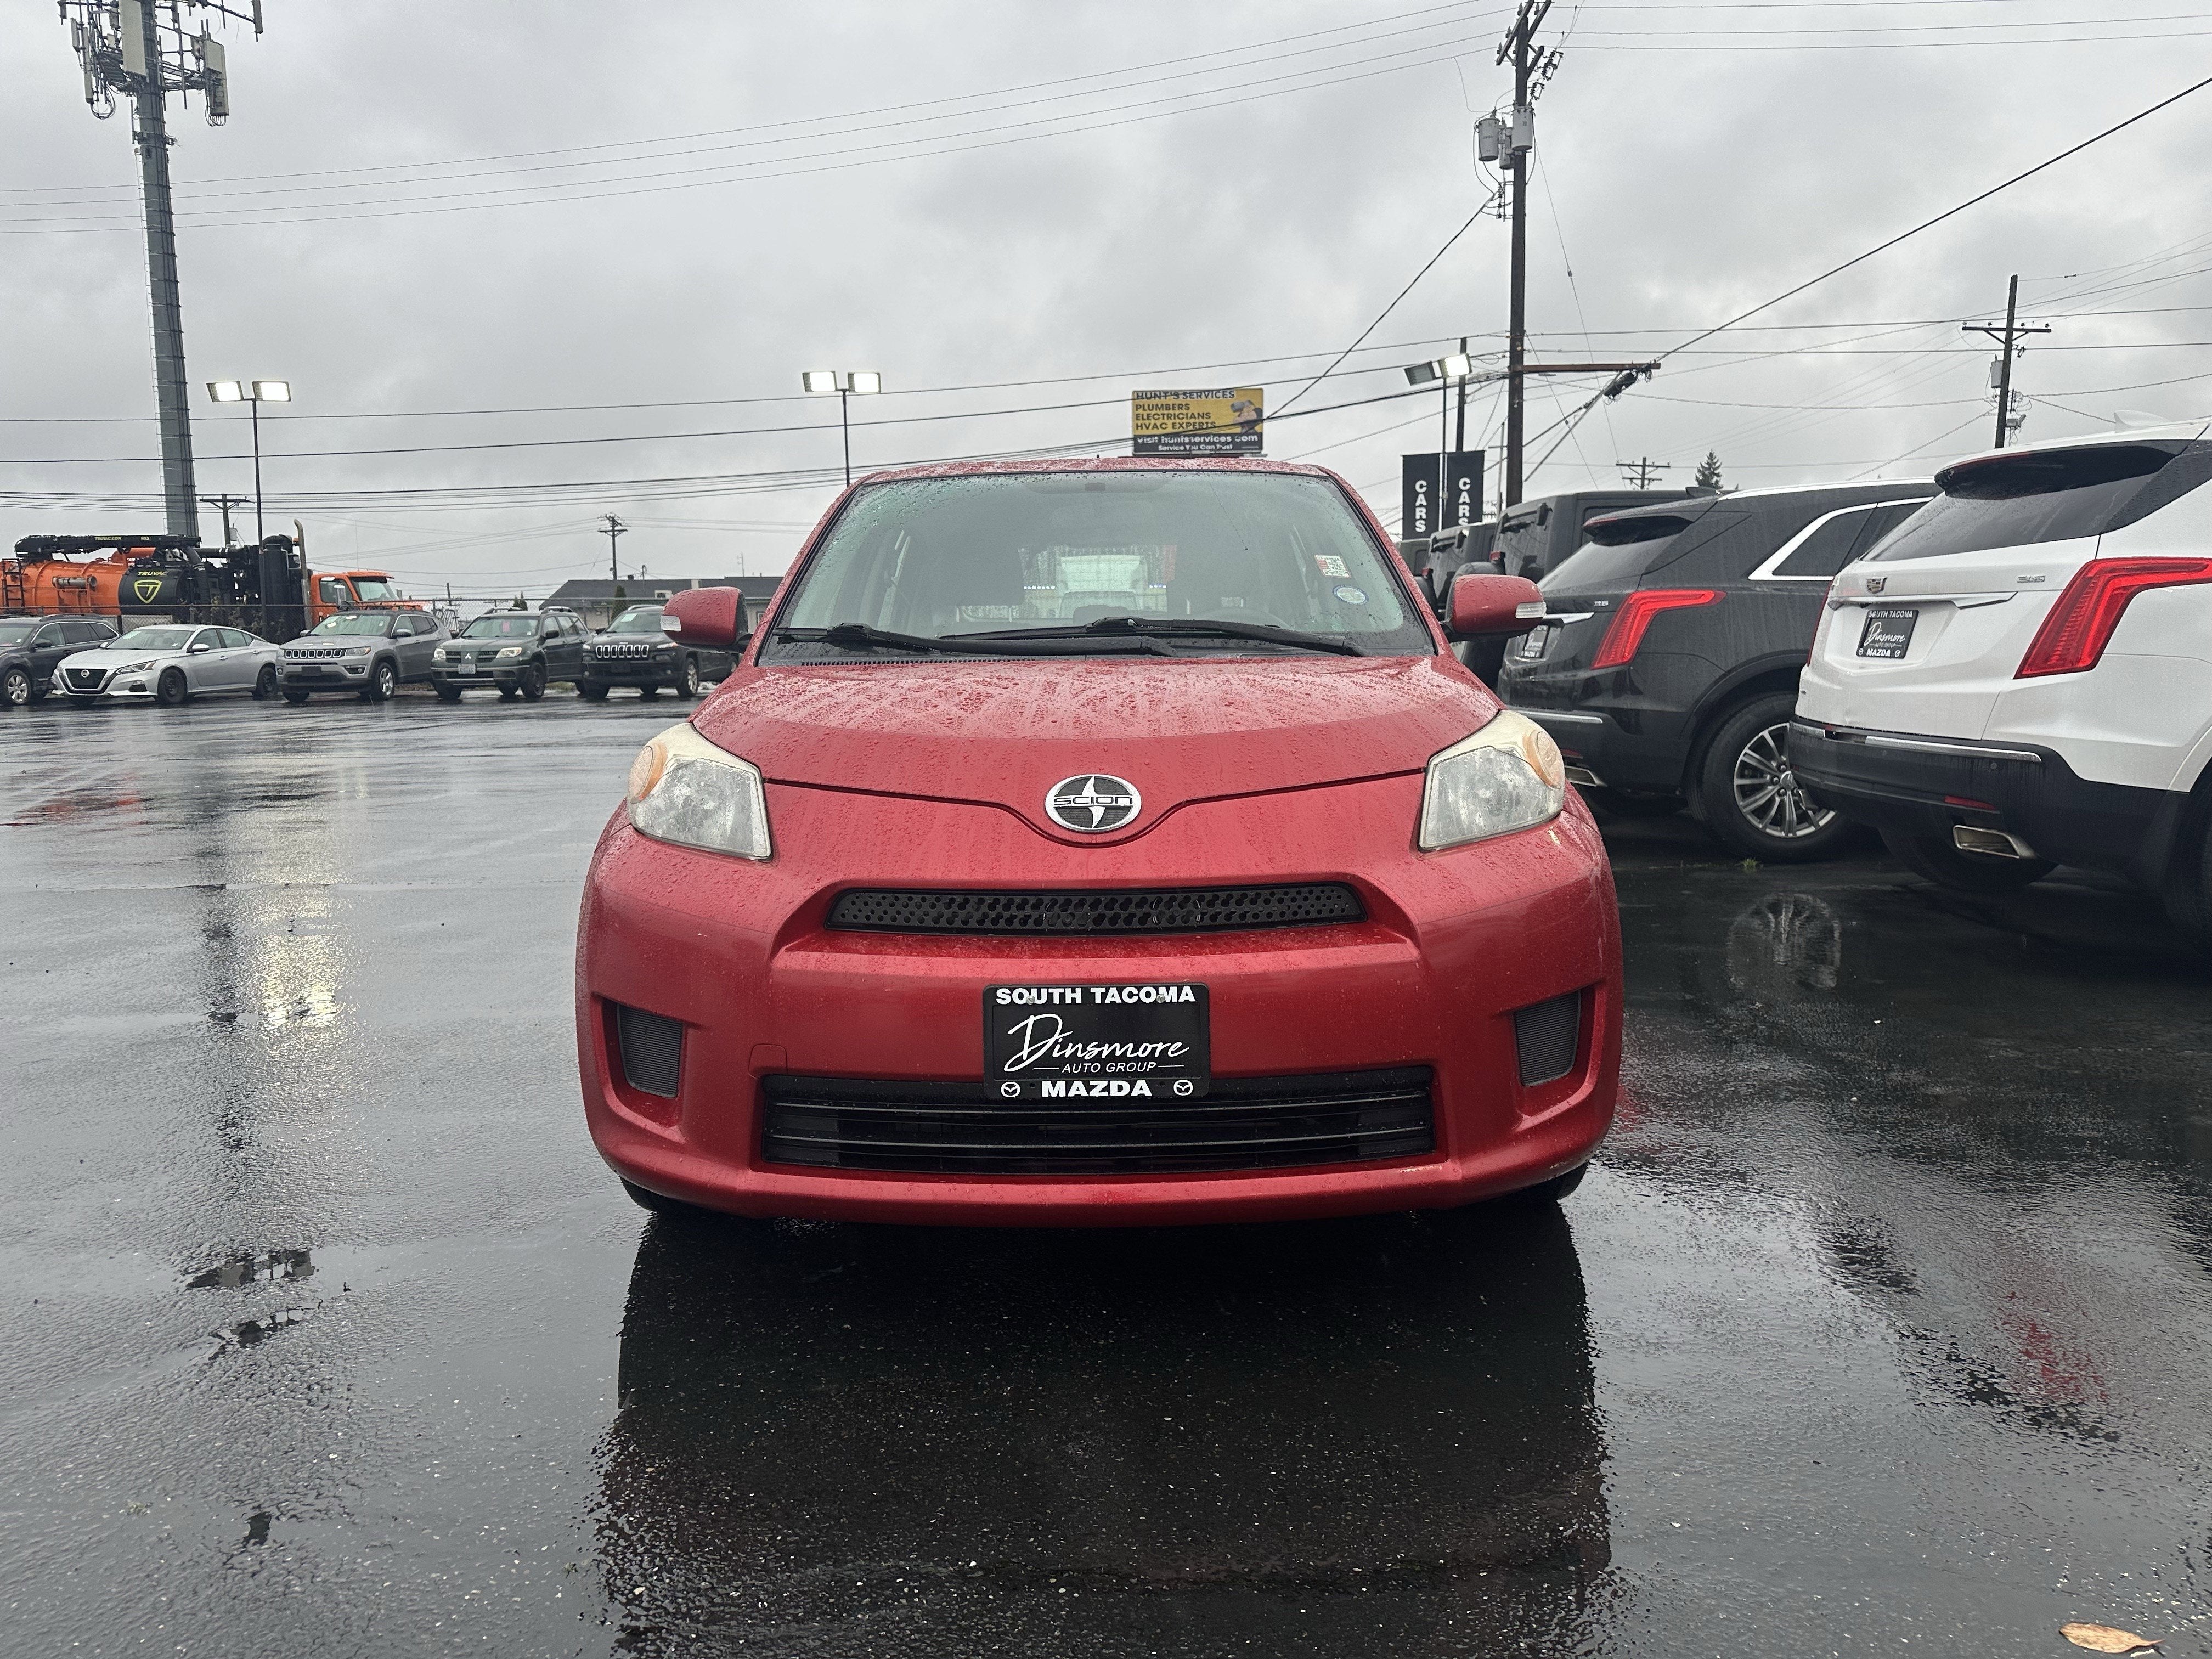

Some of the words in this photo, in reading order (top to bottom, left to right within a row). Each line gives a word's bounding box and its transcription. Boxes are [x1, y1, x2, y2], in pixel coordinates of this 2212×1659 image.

[1136, 391, 1179, 400] HUNT'S
[1182, 390, 1235, 399] SERVICES
[1136, 403, 1190, 411] PLUMBERS
[1136, 412, 1211, 421] ELECTRICIANS
[1172, 421, 1216, 430] EXPERTS
[1415, 480, 1427, 532] CARS
[1866, 648, 1891, 657] MAZDA
[996, 988, 1082, 1004] SOUTH
[1091, 986, 1195, 1003] TACOMA
[1003, 1013, 1189, 1072] Dinsmore
[1062, 1064, 1101, 1073] AUTO
[1106, 1062, 1156, 1072] GROUP
[1041, 1080, 1152, 1097] MAZDA
